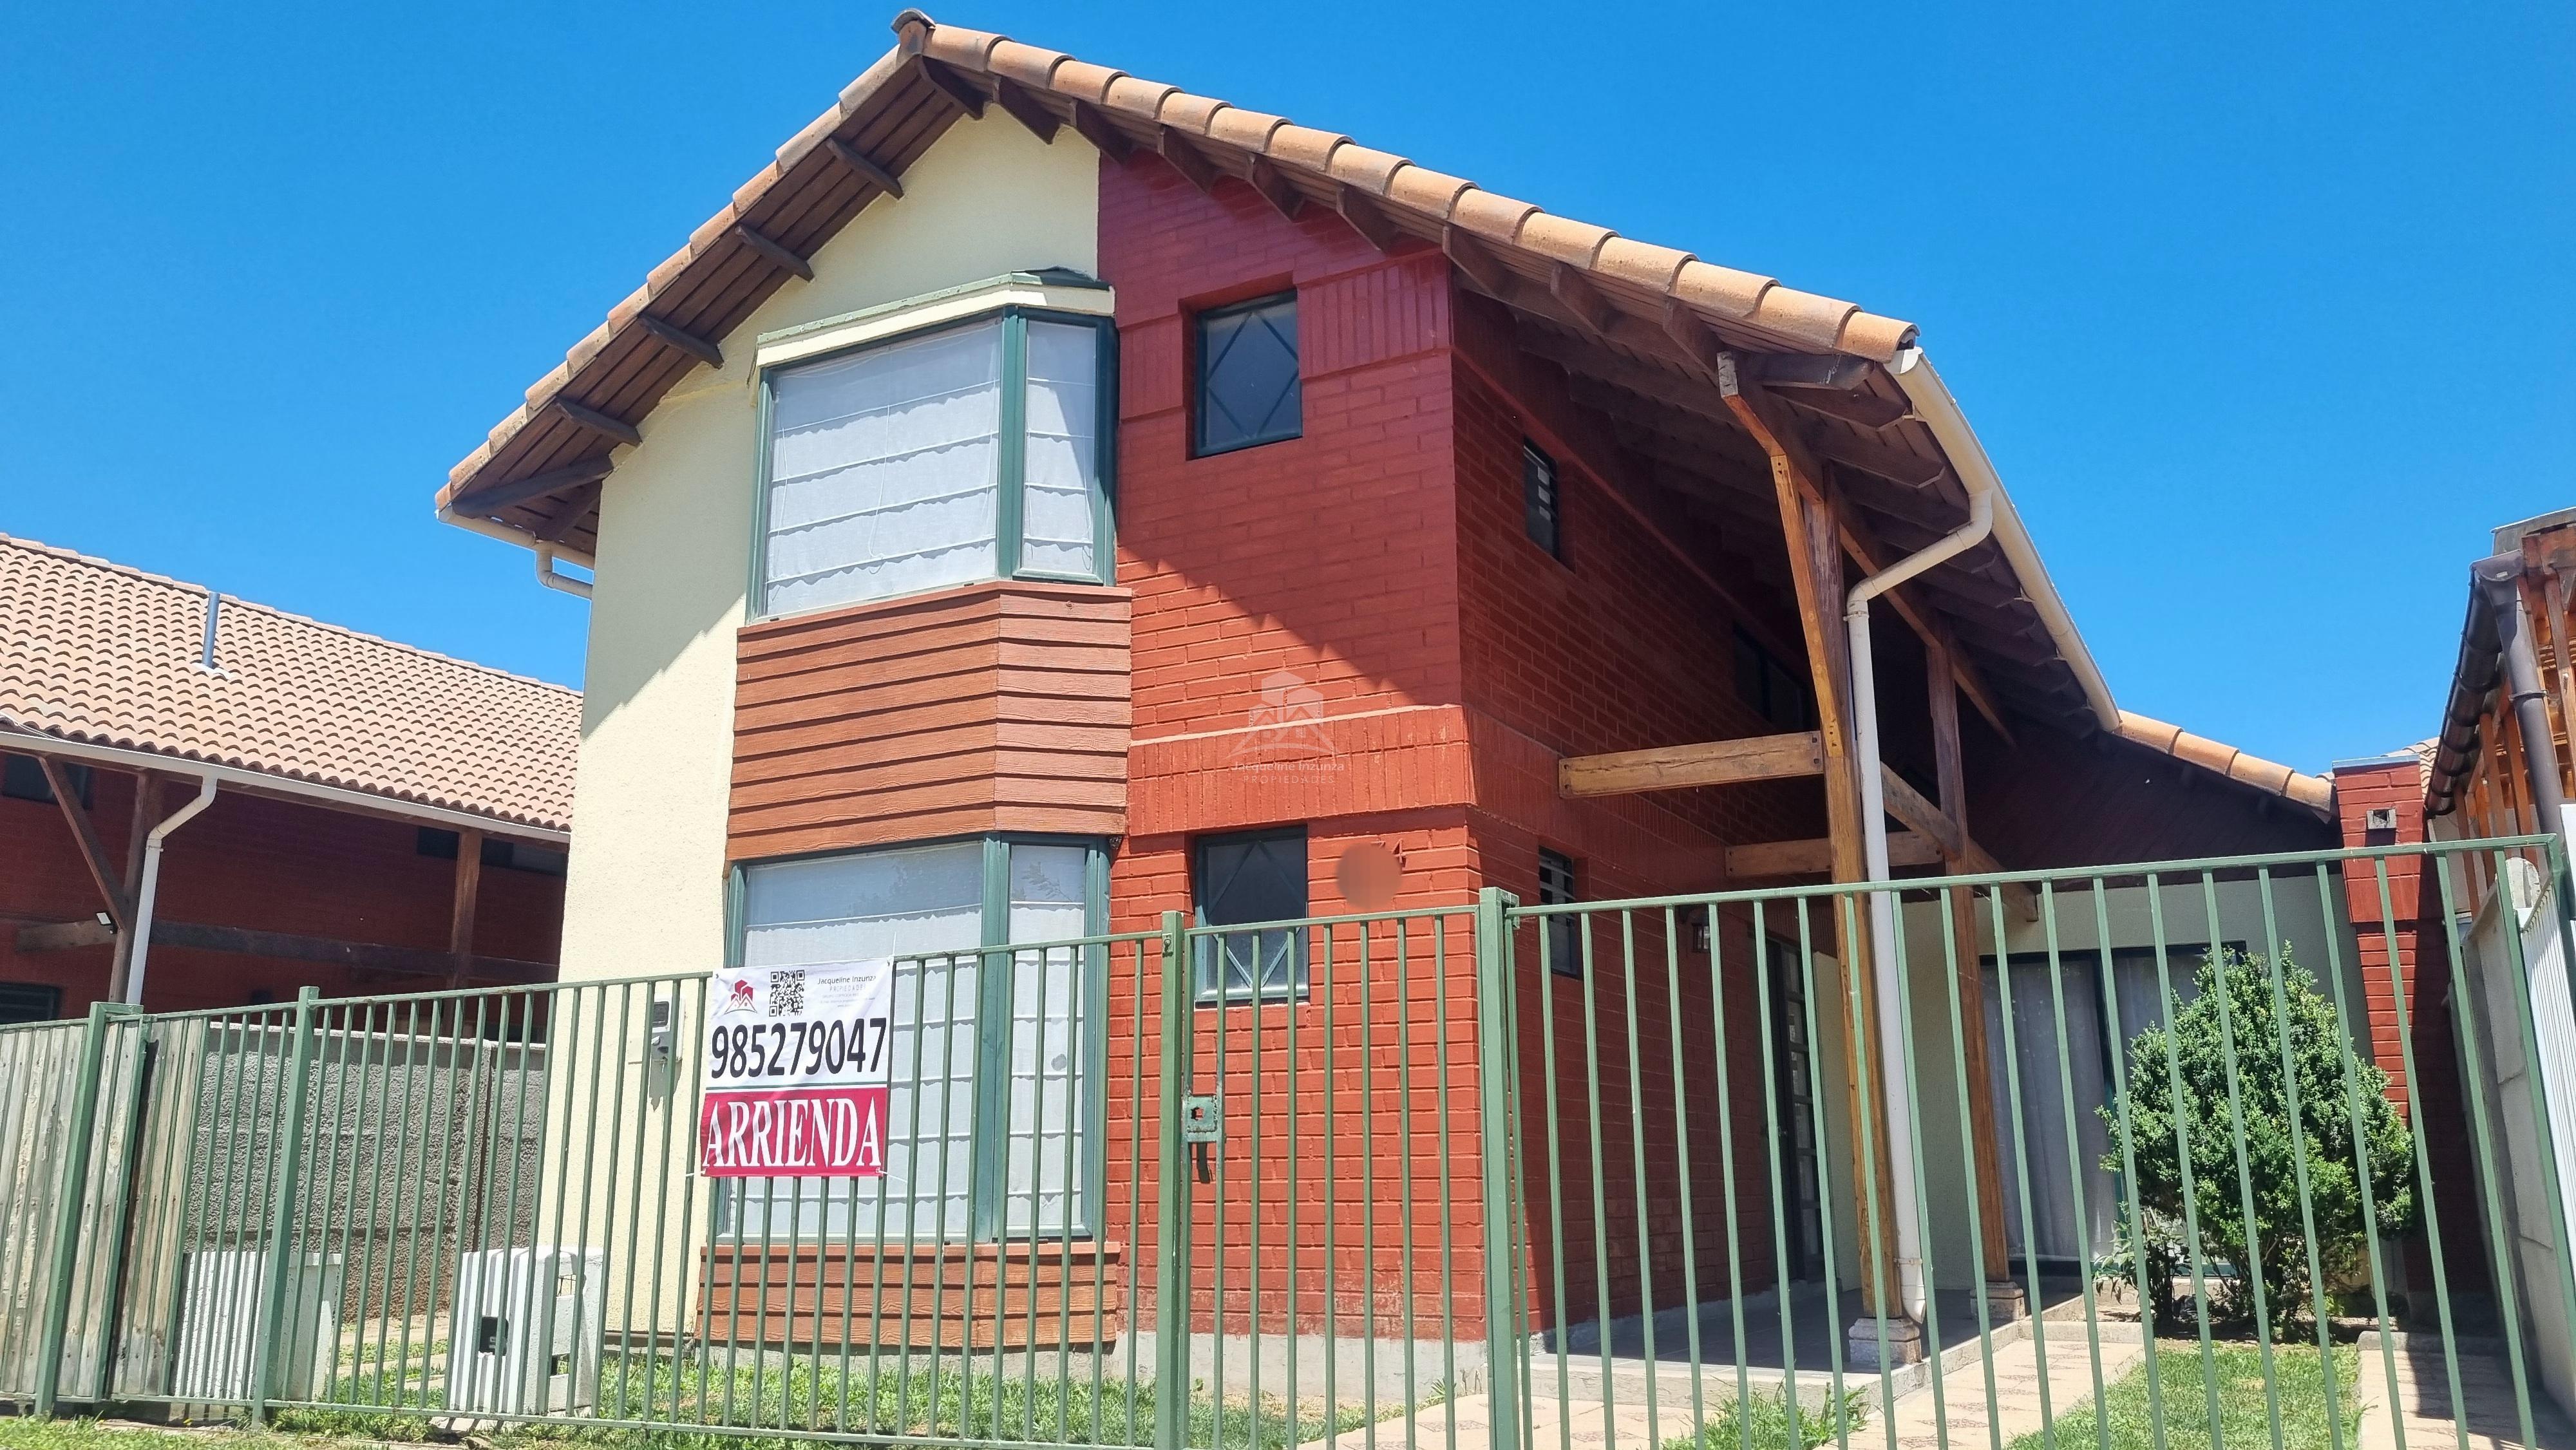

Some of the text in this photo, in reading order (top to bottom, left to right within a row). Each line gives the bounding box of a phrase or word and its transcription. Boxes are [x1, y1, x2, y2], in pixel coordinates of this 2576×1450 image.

[817, 977, 851, 986] Jacqueline
[711, 1017, 887, 1079] 985279047
[702, 1097, 882, 1169] ARRIENDA
